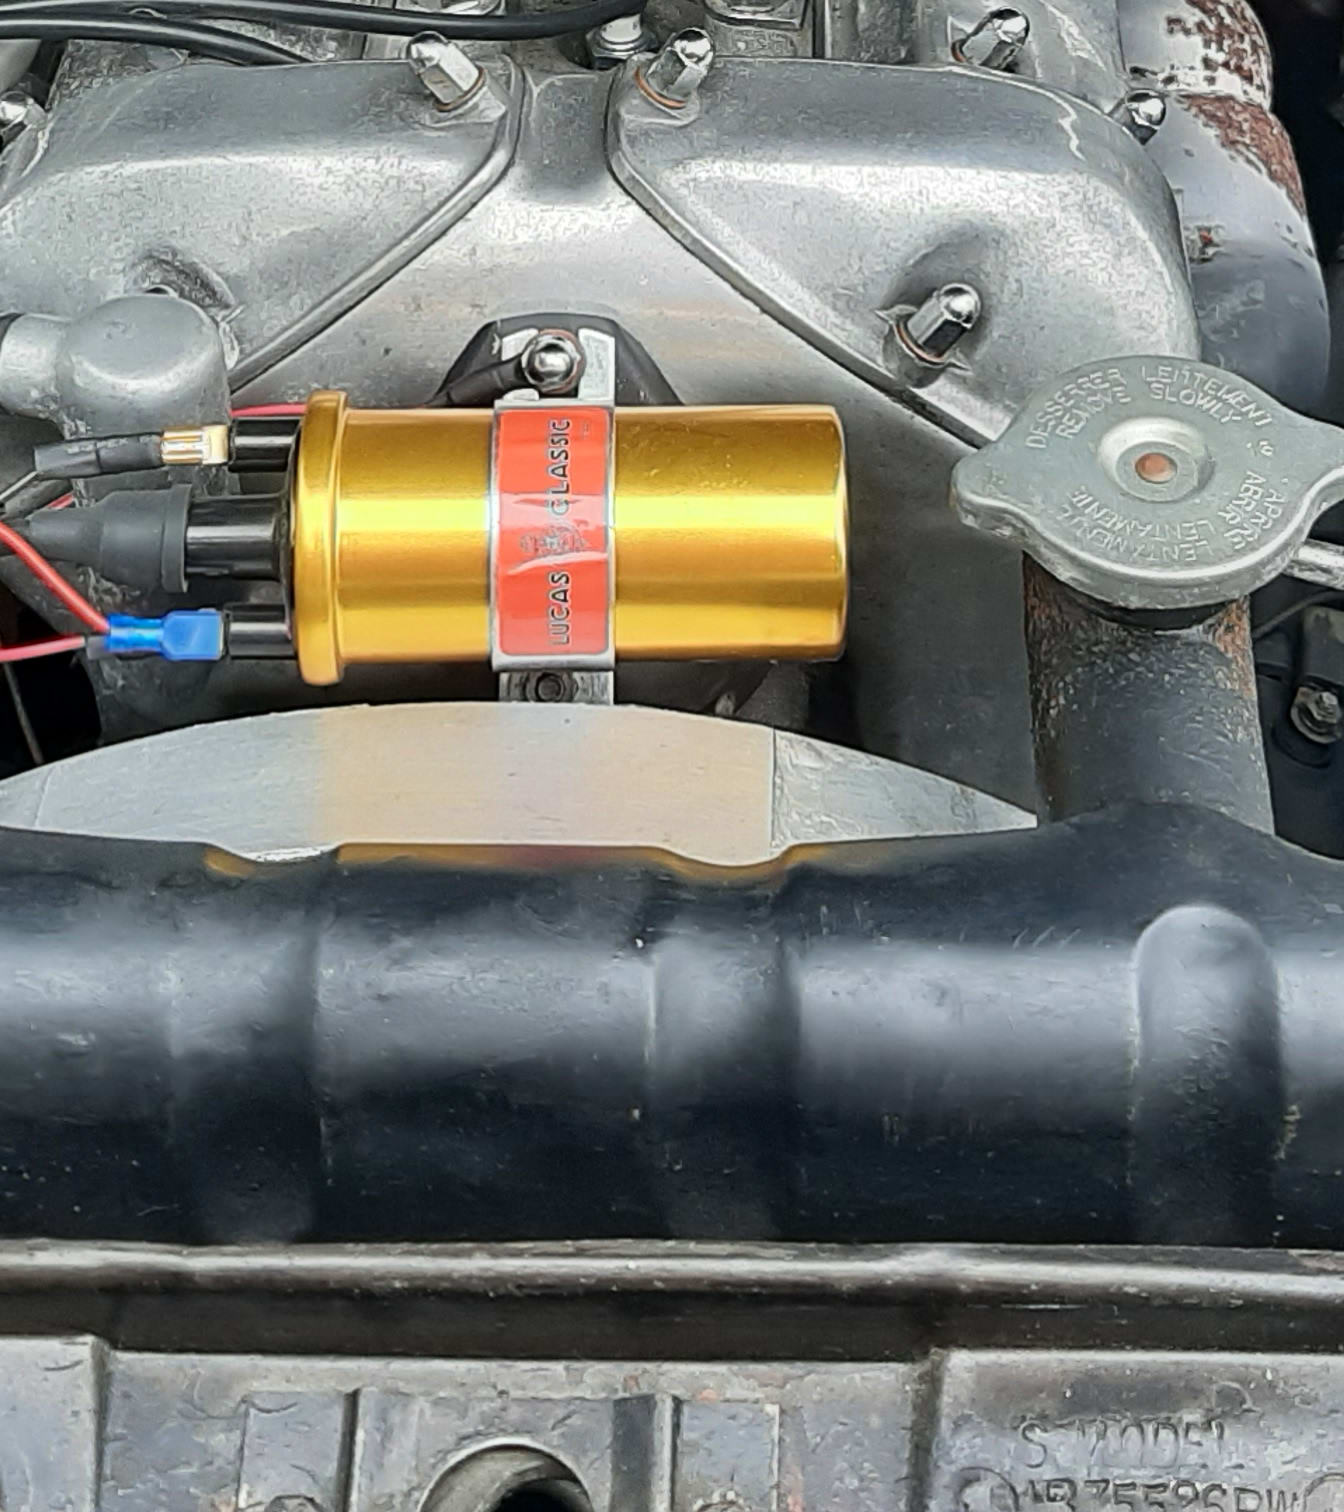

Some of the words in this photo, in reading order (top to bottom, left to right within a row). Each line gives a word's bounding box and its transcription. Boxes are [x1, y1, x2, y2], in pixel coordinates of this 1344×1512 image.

[1150, 382, 1243, 425] SLOWLY
[547, 415, 574, 518] CLASSIC
[548, 570, 574, 648] LUCAS
